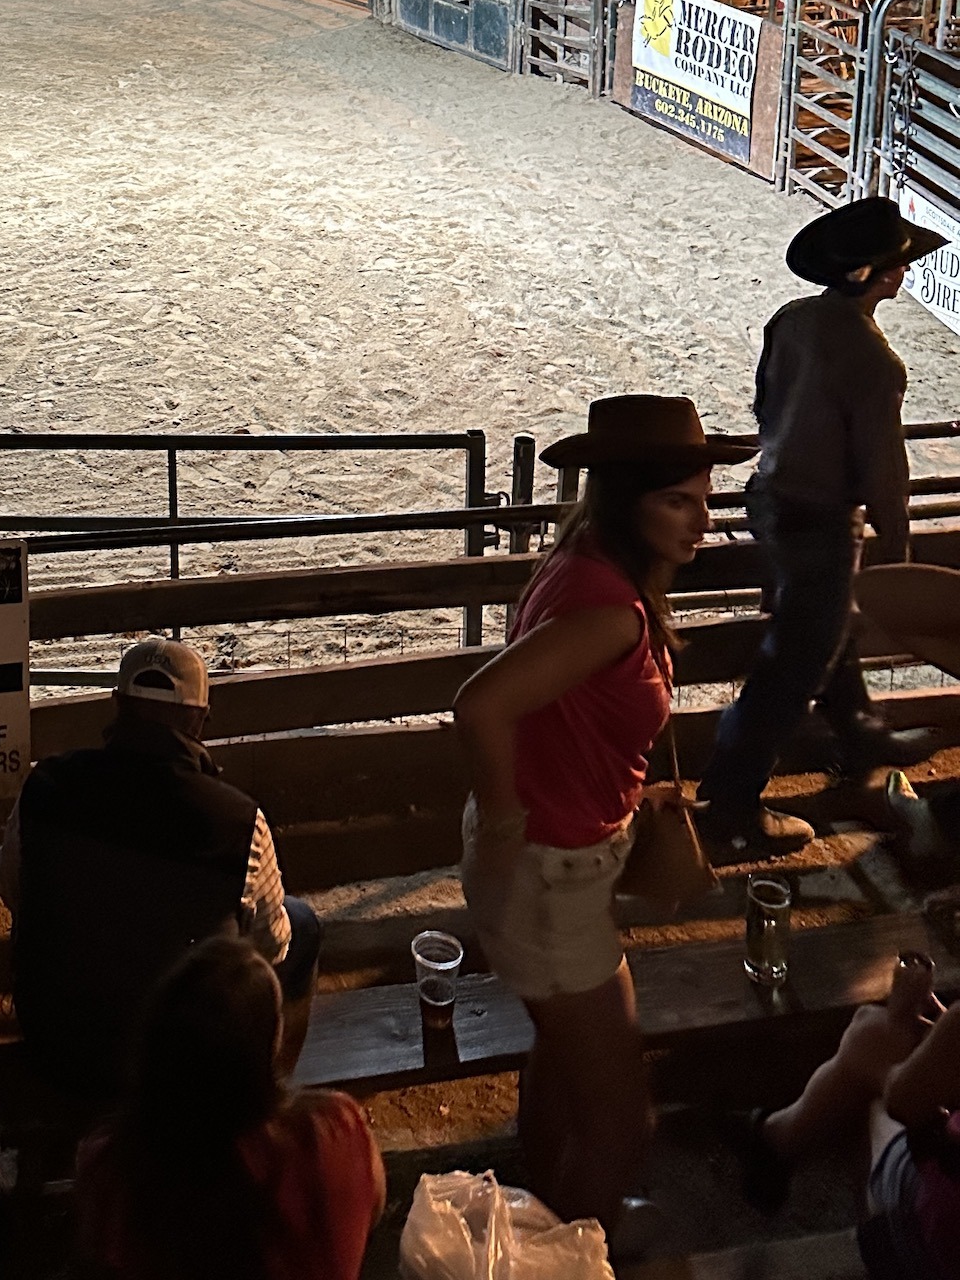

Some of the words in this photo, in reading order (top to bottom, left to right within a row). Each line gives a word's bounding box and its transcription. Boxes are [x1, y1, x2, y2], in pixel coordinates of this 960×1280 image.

[679, 0, 755, 55] MERCER
[674, 56, 729, 89] COMPANY
[730, 79, 750, 99] LLC
[675, 27, 753, 83] RODEO
[635, 70, 693, 111] BUCKEYE,
[695, 96, 749, 137] ARIZONA
[654, 98, 725, 143] 602.345.1175
[925, 206, 956, 233] SCOTTSDALE
